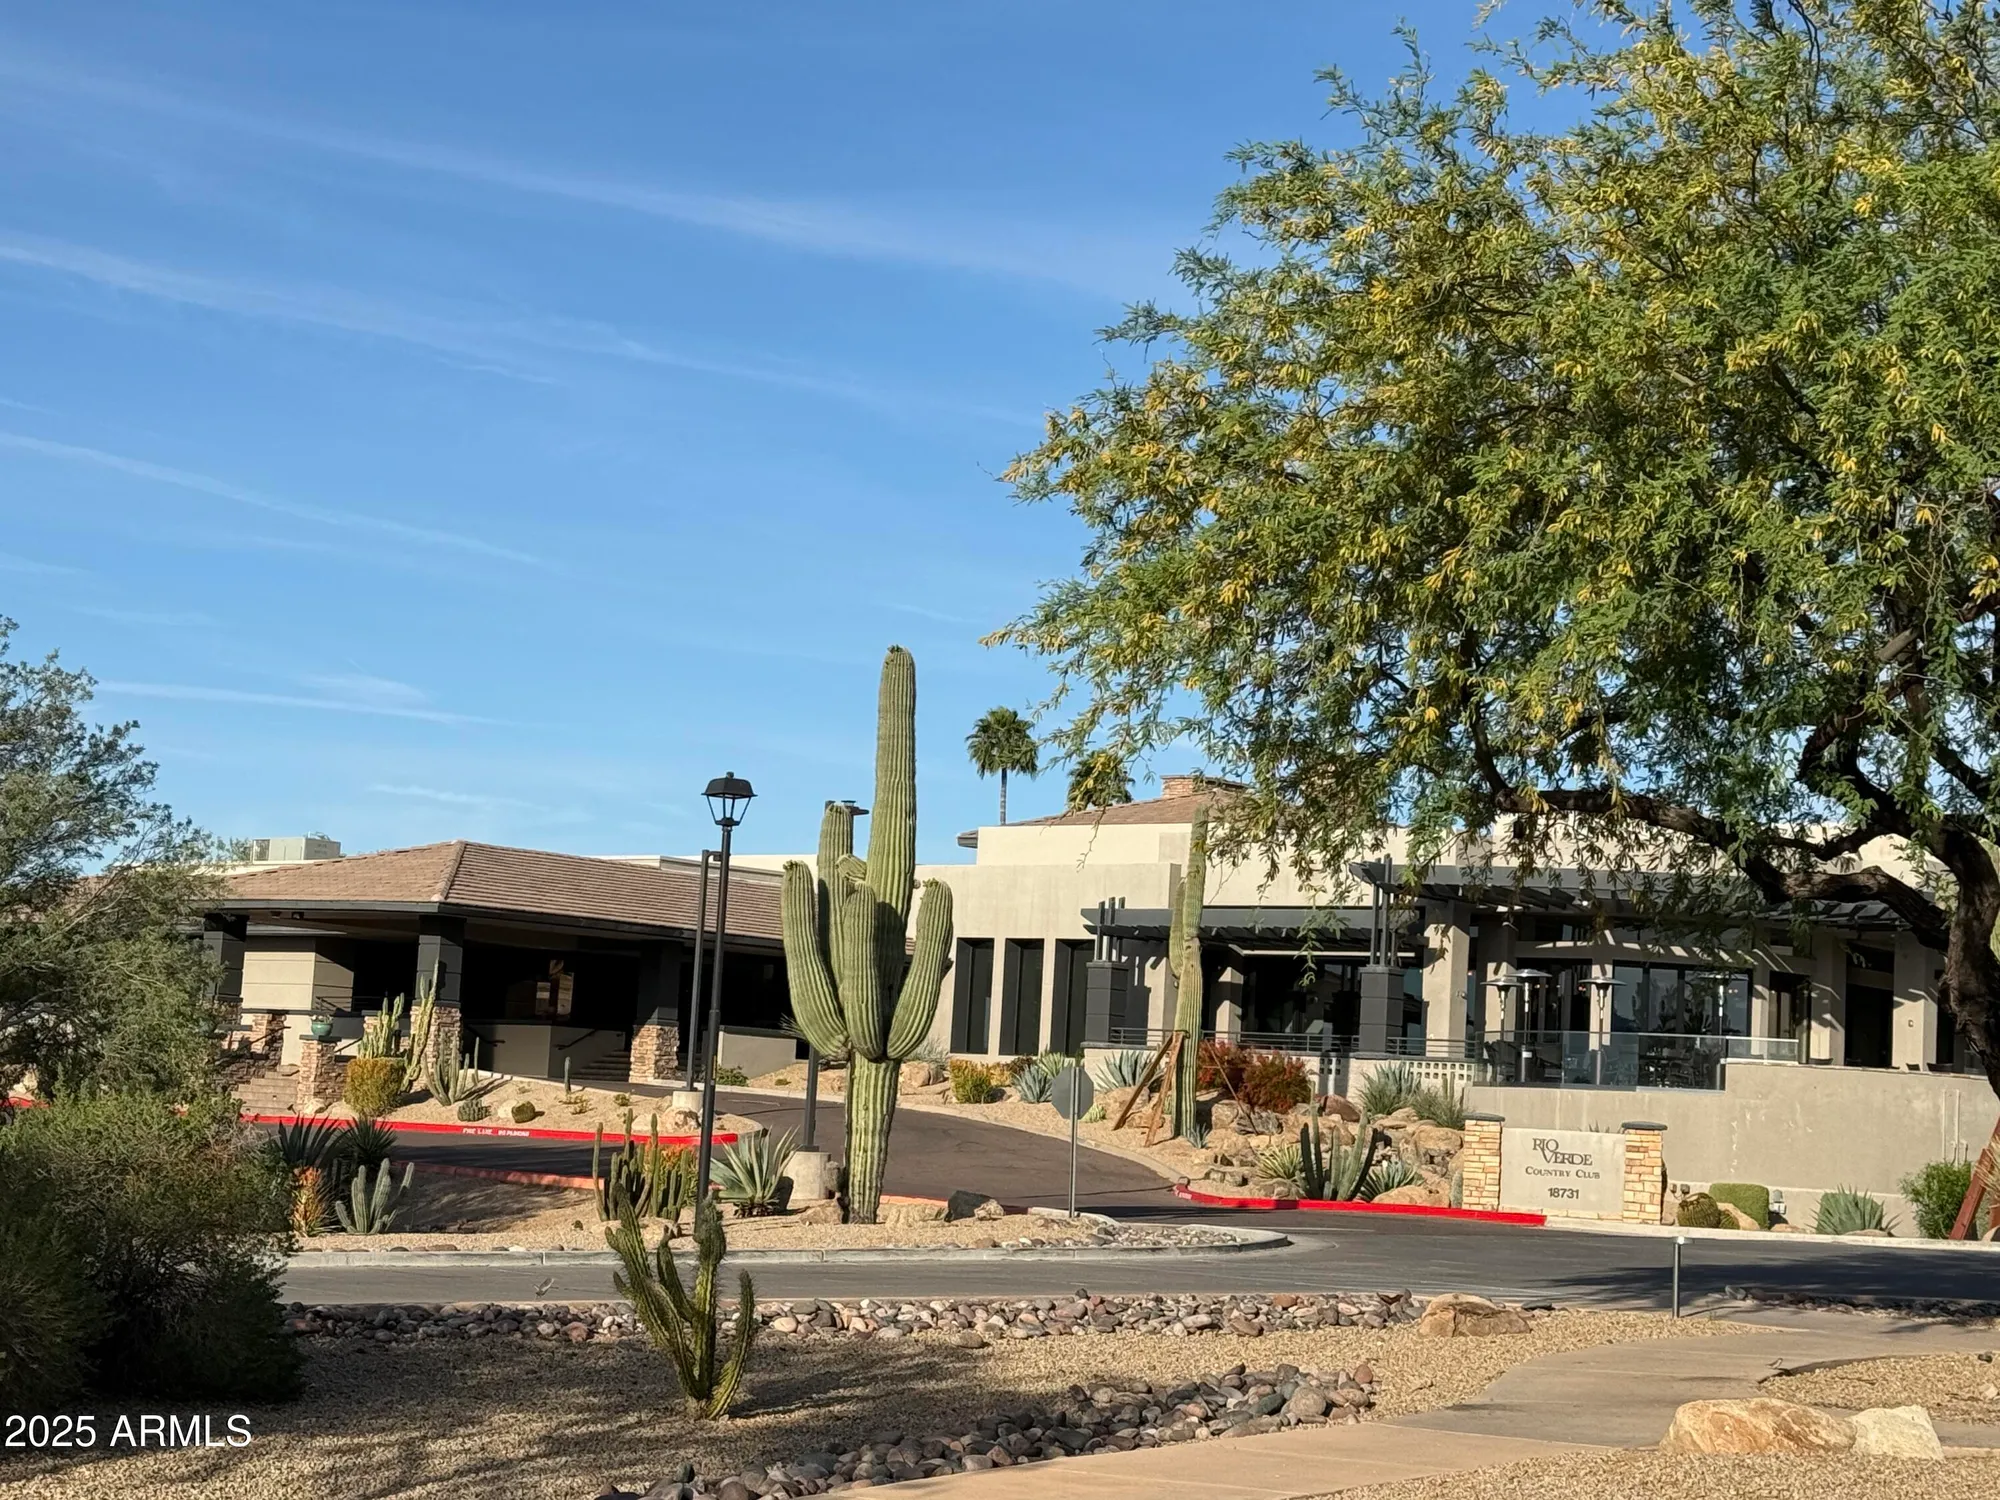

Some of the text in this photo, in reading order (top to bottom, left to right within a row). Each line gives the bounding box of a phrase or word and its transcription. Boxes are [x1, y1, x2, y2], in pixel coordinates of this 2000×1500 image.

[1532, 1138, 1559, 1152] RIO
[1542, 1151, 1593, 1166] VERDE
[1548, 1187, 1579, 1199] 18731
